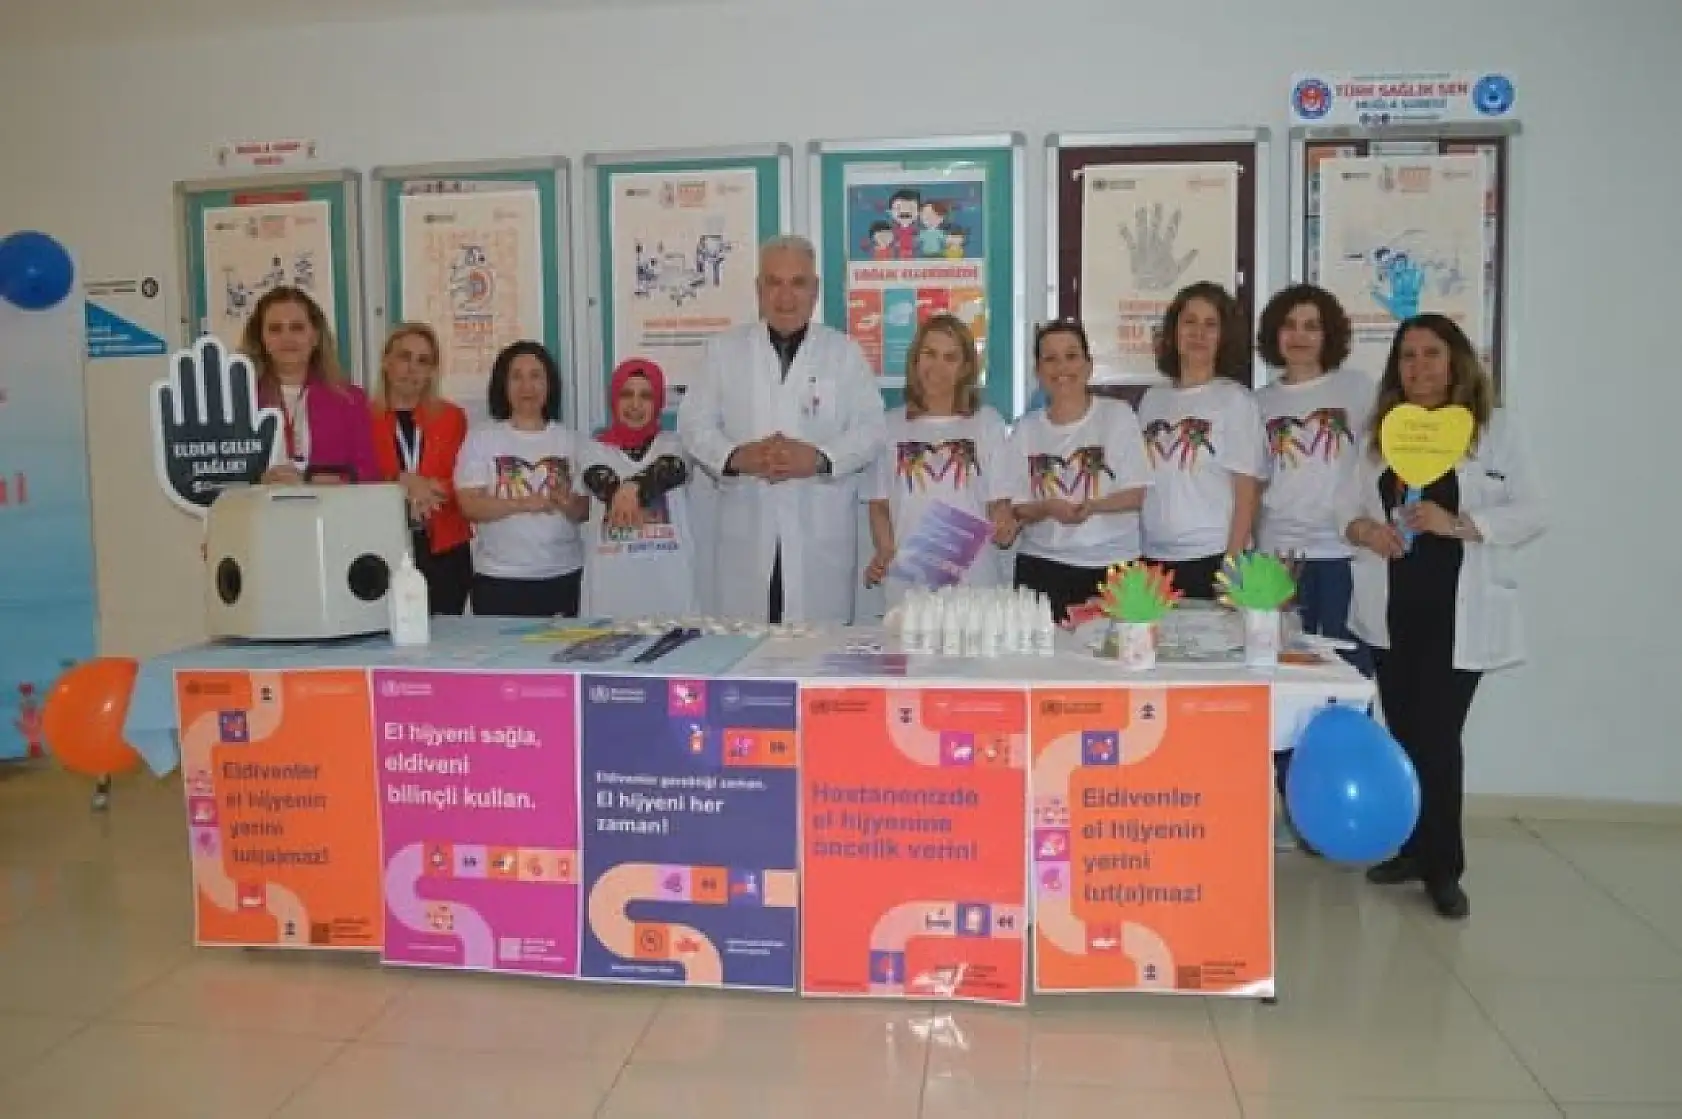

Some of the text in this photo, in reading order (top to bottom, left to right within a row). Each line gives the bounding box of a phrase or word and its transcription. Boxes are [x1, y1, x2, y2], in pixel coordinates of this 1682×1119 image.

[173, 439, 263, 458] ELDEN GELEN
[384, 722, 542, 748] El hijyeni sağla,
[223, 762, 321, 781] Eldivenler
[385, 752, 470, 776] eldiveni
[227, 790, 327, 812] el hijyenin
[387, 784, 536, 811] bilinçli kullan.
[596, 790, 725, 814] El hijyeni her
[1083, 787, 1203, 808] Eldivenler
[595, 816, 669, 836] zaman!
[812, 811, 833, 831] el
[1082, 819, 1206, 844] el hijyenin
[1082, 851, 1151, 873] yerini
